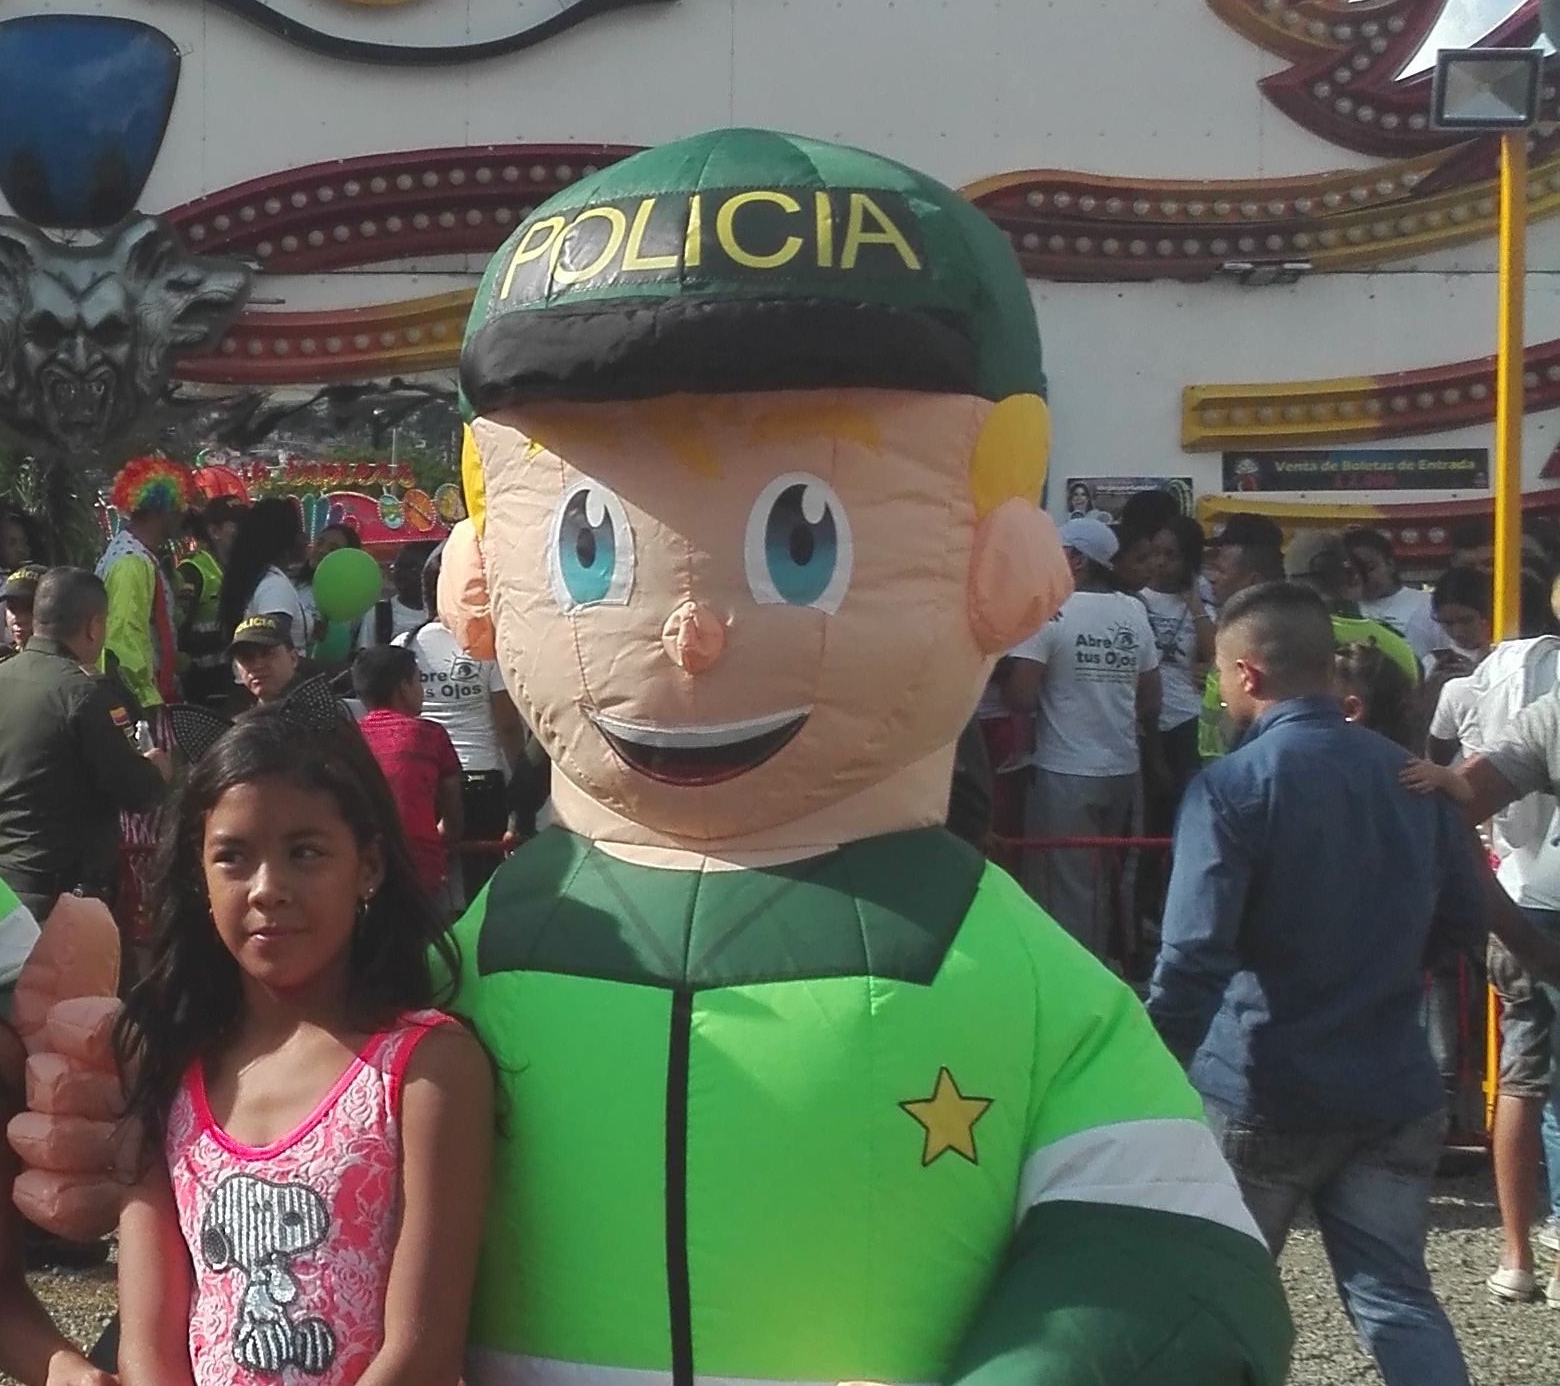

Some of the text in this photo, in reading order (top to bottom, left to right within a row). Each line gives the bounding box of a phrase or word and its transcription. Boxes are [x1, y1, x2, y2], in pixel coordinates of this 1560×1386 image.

[500, 190, 922, 301] POLICIA
[1275, 459, 1476, 472] Venta de Boletas de Entrada
[1075, 633, 1113, 649] Abre
[1075, 650, 1137, 668] tus Ojos
[419, 670, 448, 683] bre
[441, 683, 482, 700] Ojos
